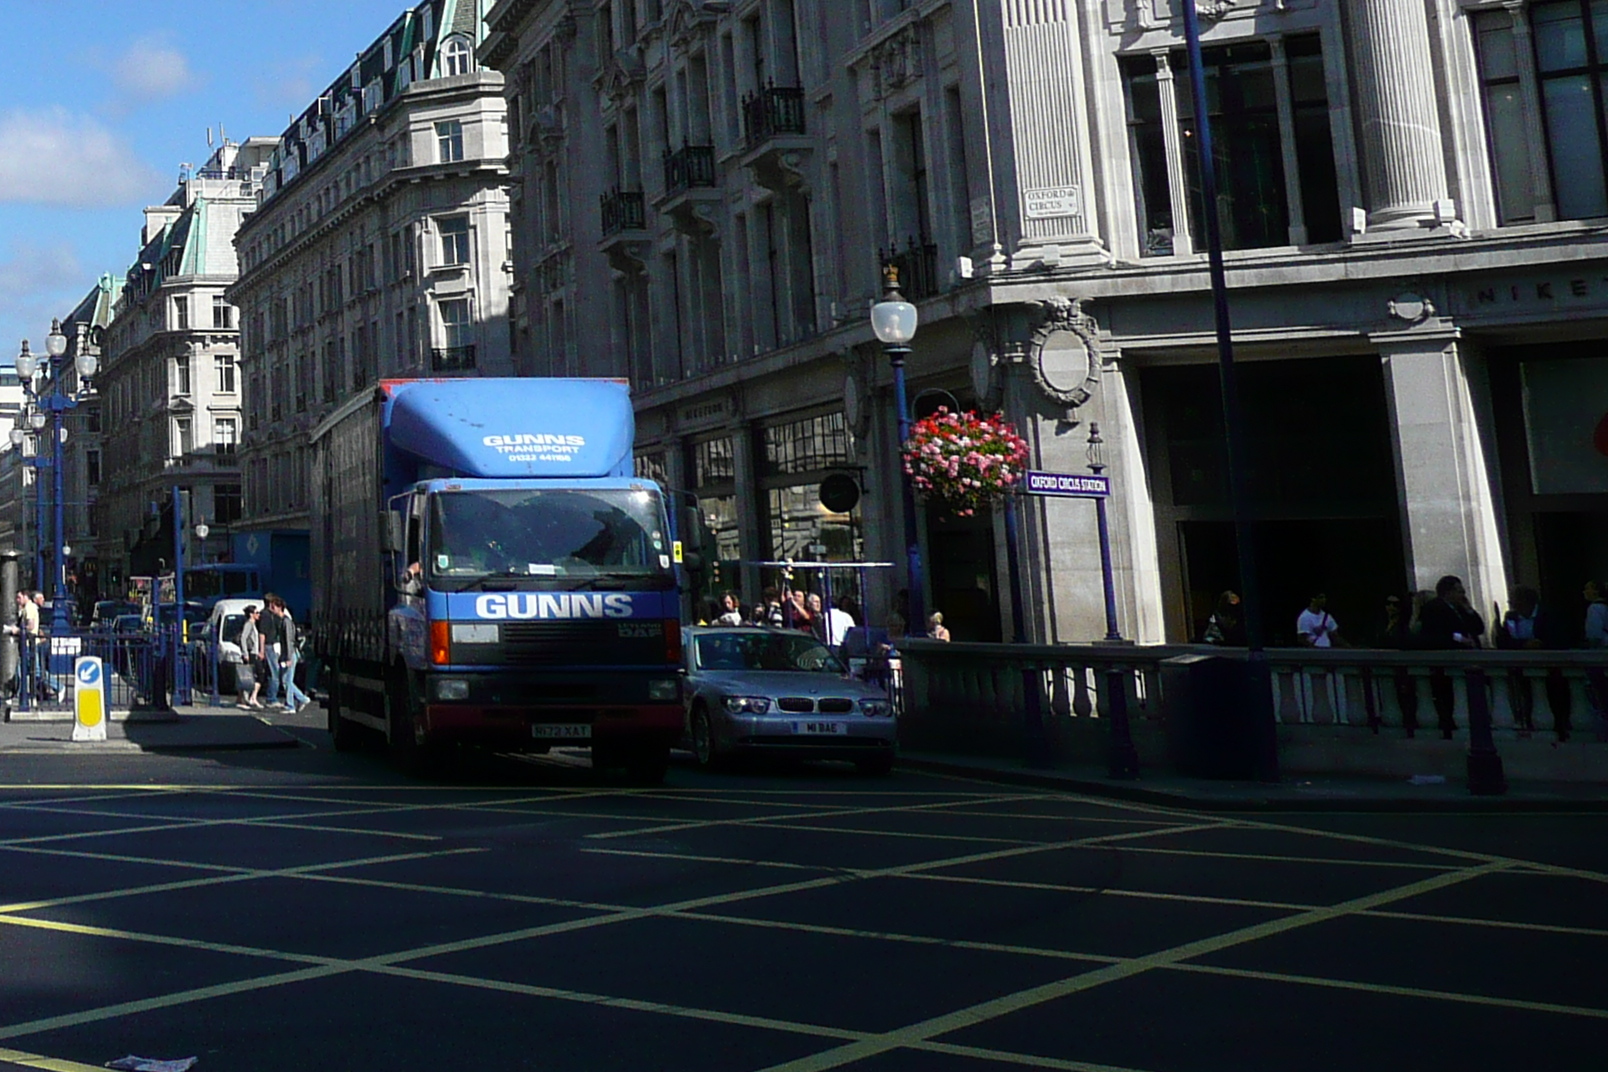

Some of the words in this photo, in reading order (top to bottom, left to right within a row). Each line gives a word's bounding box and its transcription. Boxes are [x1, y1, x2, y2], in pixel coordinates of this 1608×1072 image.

[1028, 190, 1066, 200] OXFORD
[1029, 201, 1062, 211] CIRCUS
[1478, 277, 1608, 303] NIKE
[482, 434, 585, 446] GUNNS
[495, 445, 580, 454] TRANSPORT
[1031, 475, 1057, 488] OXFORD
[1058, 477, 1080, 490] CIRCUS
[1081, 479, 1106, 491] STATION
[476, 594, 634, 619] GUNNS
[618, 628, 662, 638] DAF
